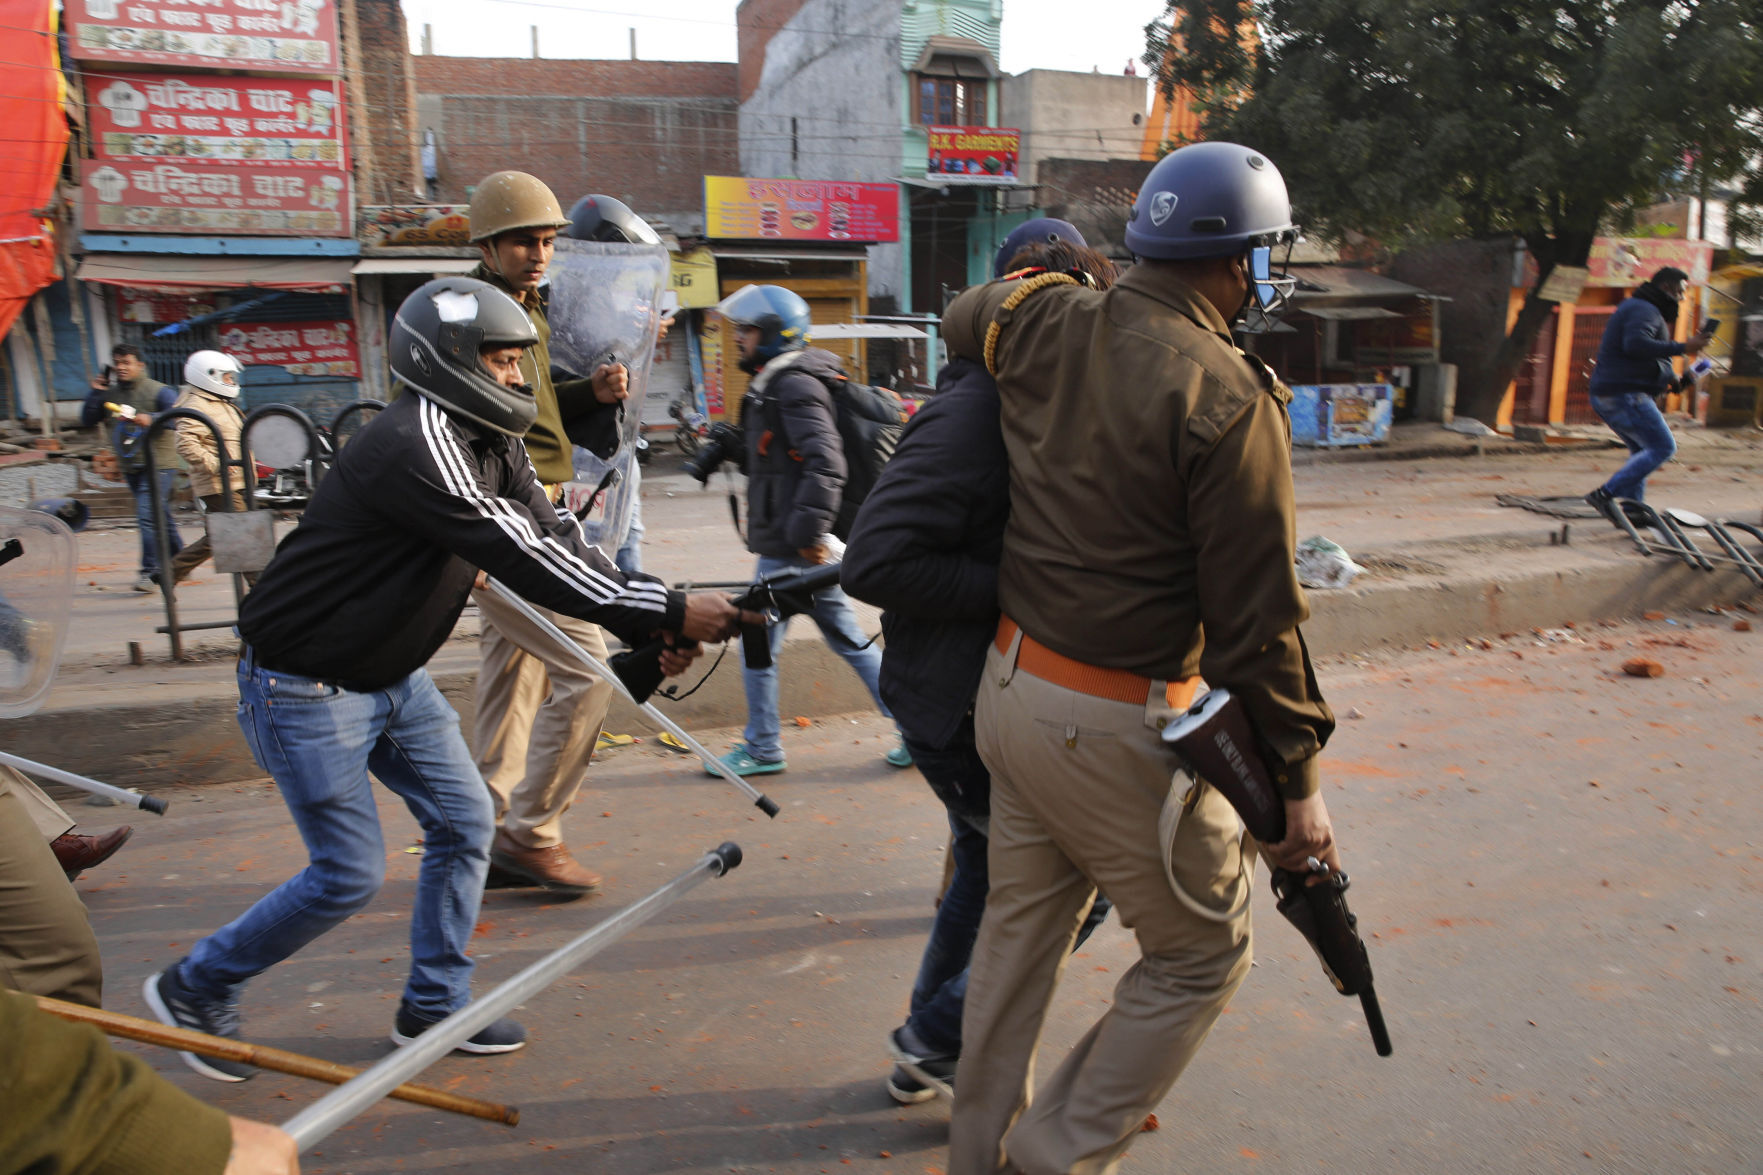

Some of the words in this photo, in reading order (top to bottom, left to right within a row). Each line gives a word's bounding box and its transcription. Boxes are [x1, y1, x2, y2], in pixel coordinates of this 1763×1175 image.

[144, 79, 241, 112] चन्द्रिका
[246, 88, 294, 113] चाट
[955, 134, 1019, 153] GARMENTS
[130, 165, 243, 196] चन्द्रिका
[251, 175, 305, 198] चाट
